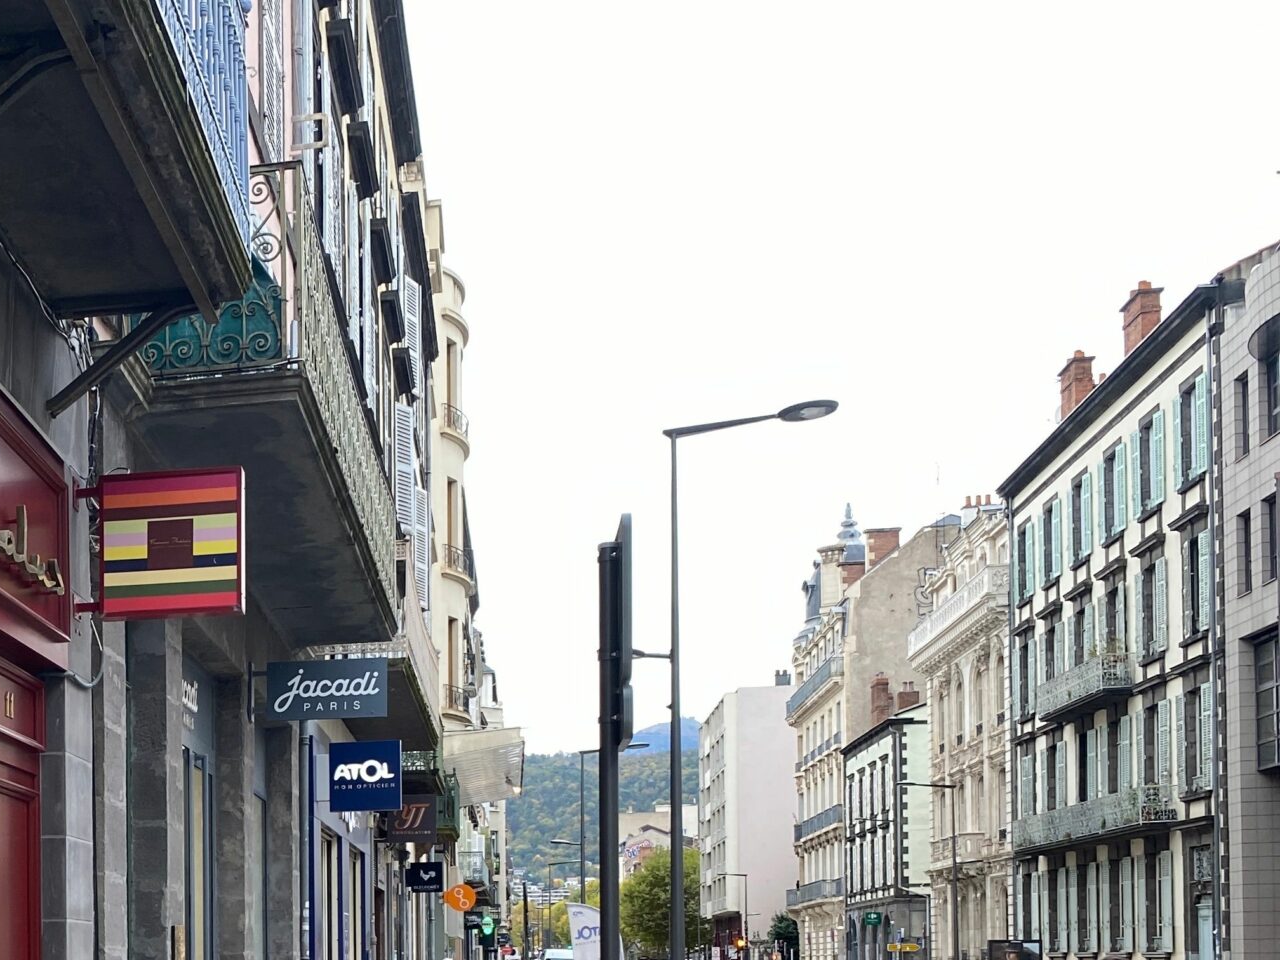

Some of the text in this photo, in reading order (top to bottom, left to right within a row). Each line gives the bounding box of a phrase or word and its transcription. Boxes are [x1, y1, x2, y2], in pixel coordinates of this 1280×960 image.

[274, 668, 380, 713] jacadi
[303, 700, 361, 712] PARIS
[333, 759, 395, 782] ATOL
